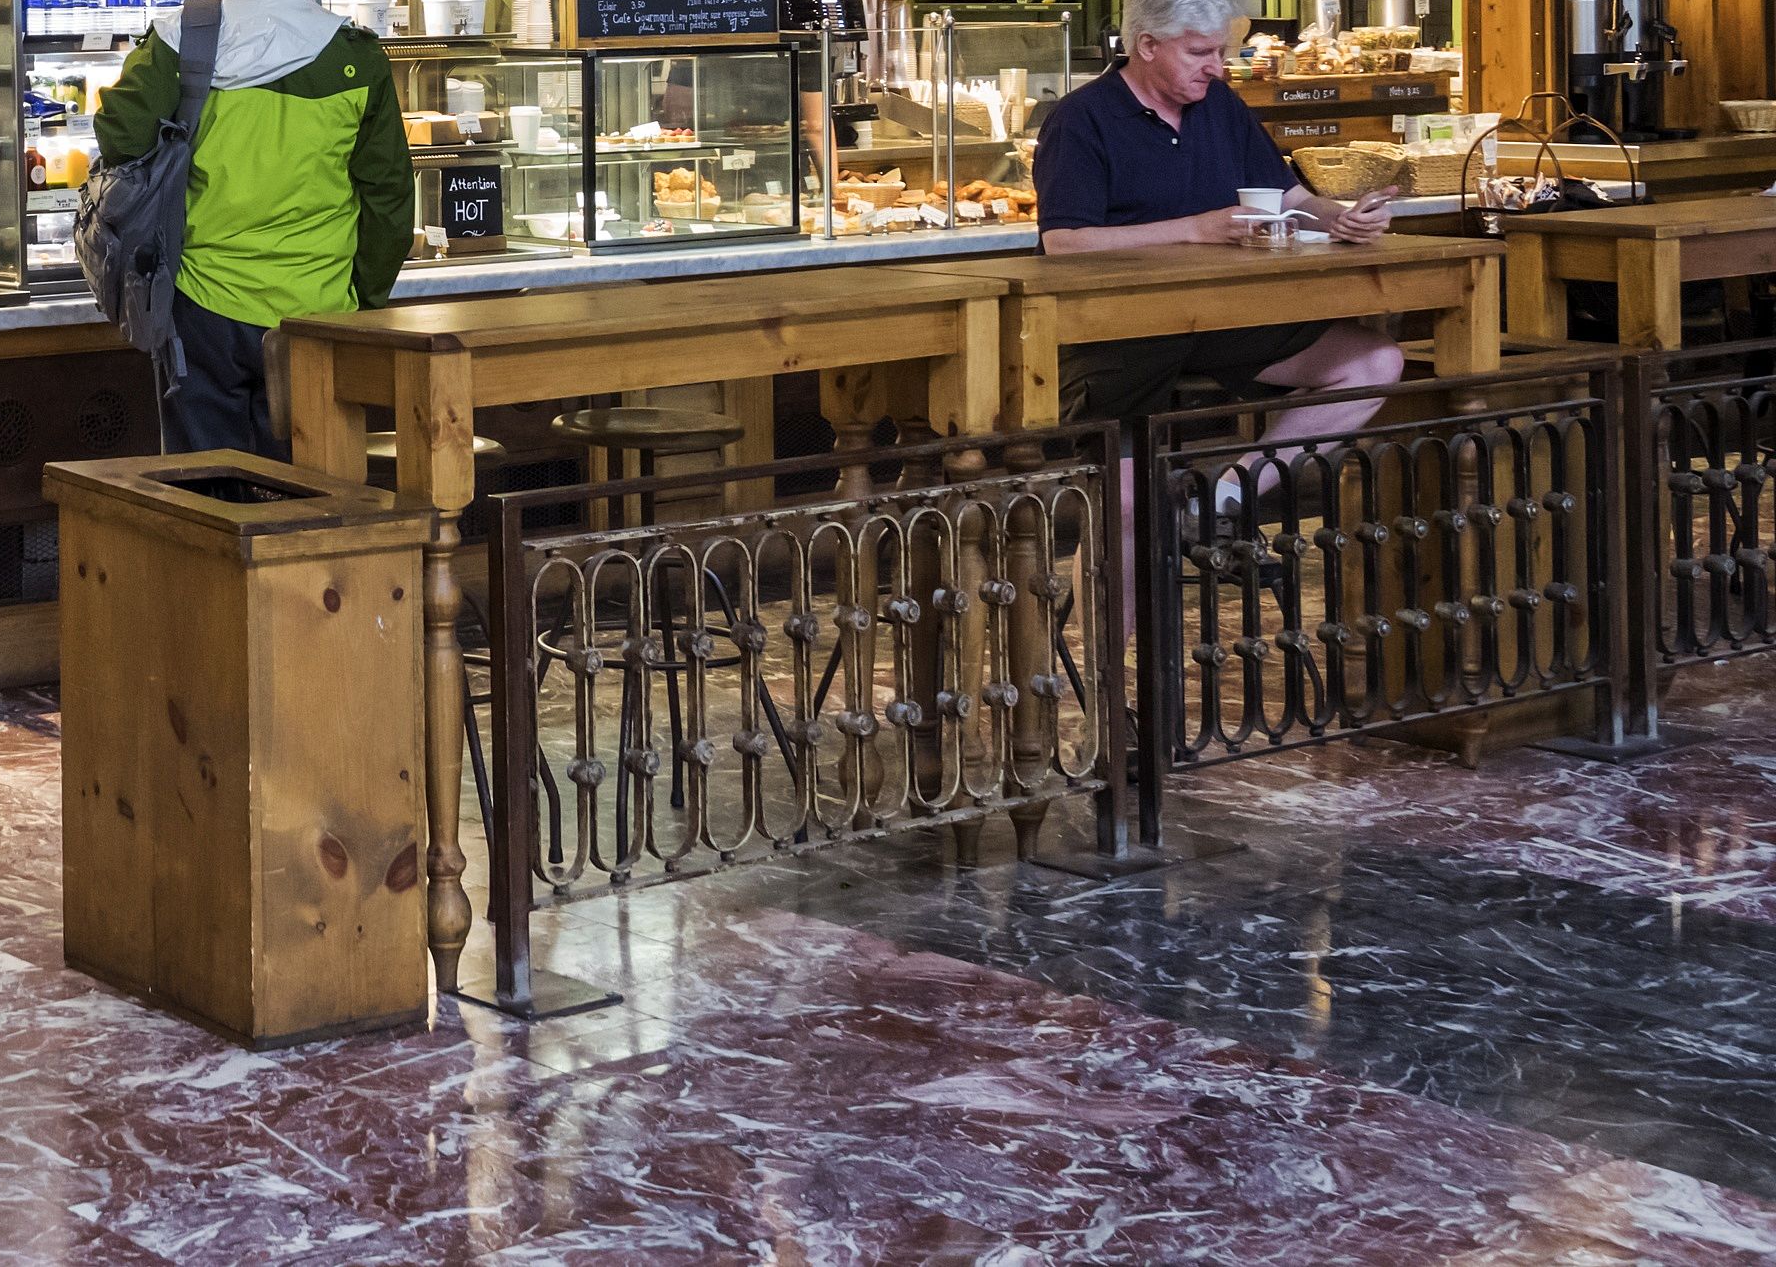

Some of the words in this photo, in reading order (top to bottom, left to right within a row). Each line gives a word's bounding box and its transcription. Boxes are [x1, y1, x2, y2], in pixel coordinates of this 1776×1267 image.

[597, 0, 618, 11] Eclair
[612, 12, 631, 24] Cafe
[634, 9, 675, 23] Gourmand
[688, 9, 709, 22] regular
[722, 11, 747, 21] espresso
[638, 22, 656, 34] plus
[659, 23, 665, 34] 3
[668, 22, 686, 31] mini
[689, 19, 718, 33] pastries
[1283, 91, 1311, 101] Cookies
[1284, 126, 1305, 136] Fresh
[449, 176, 497, 192] Attention
[454, 199, 489, 222] HOT
